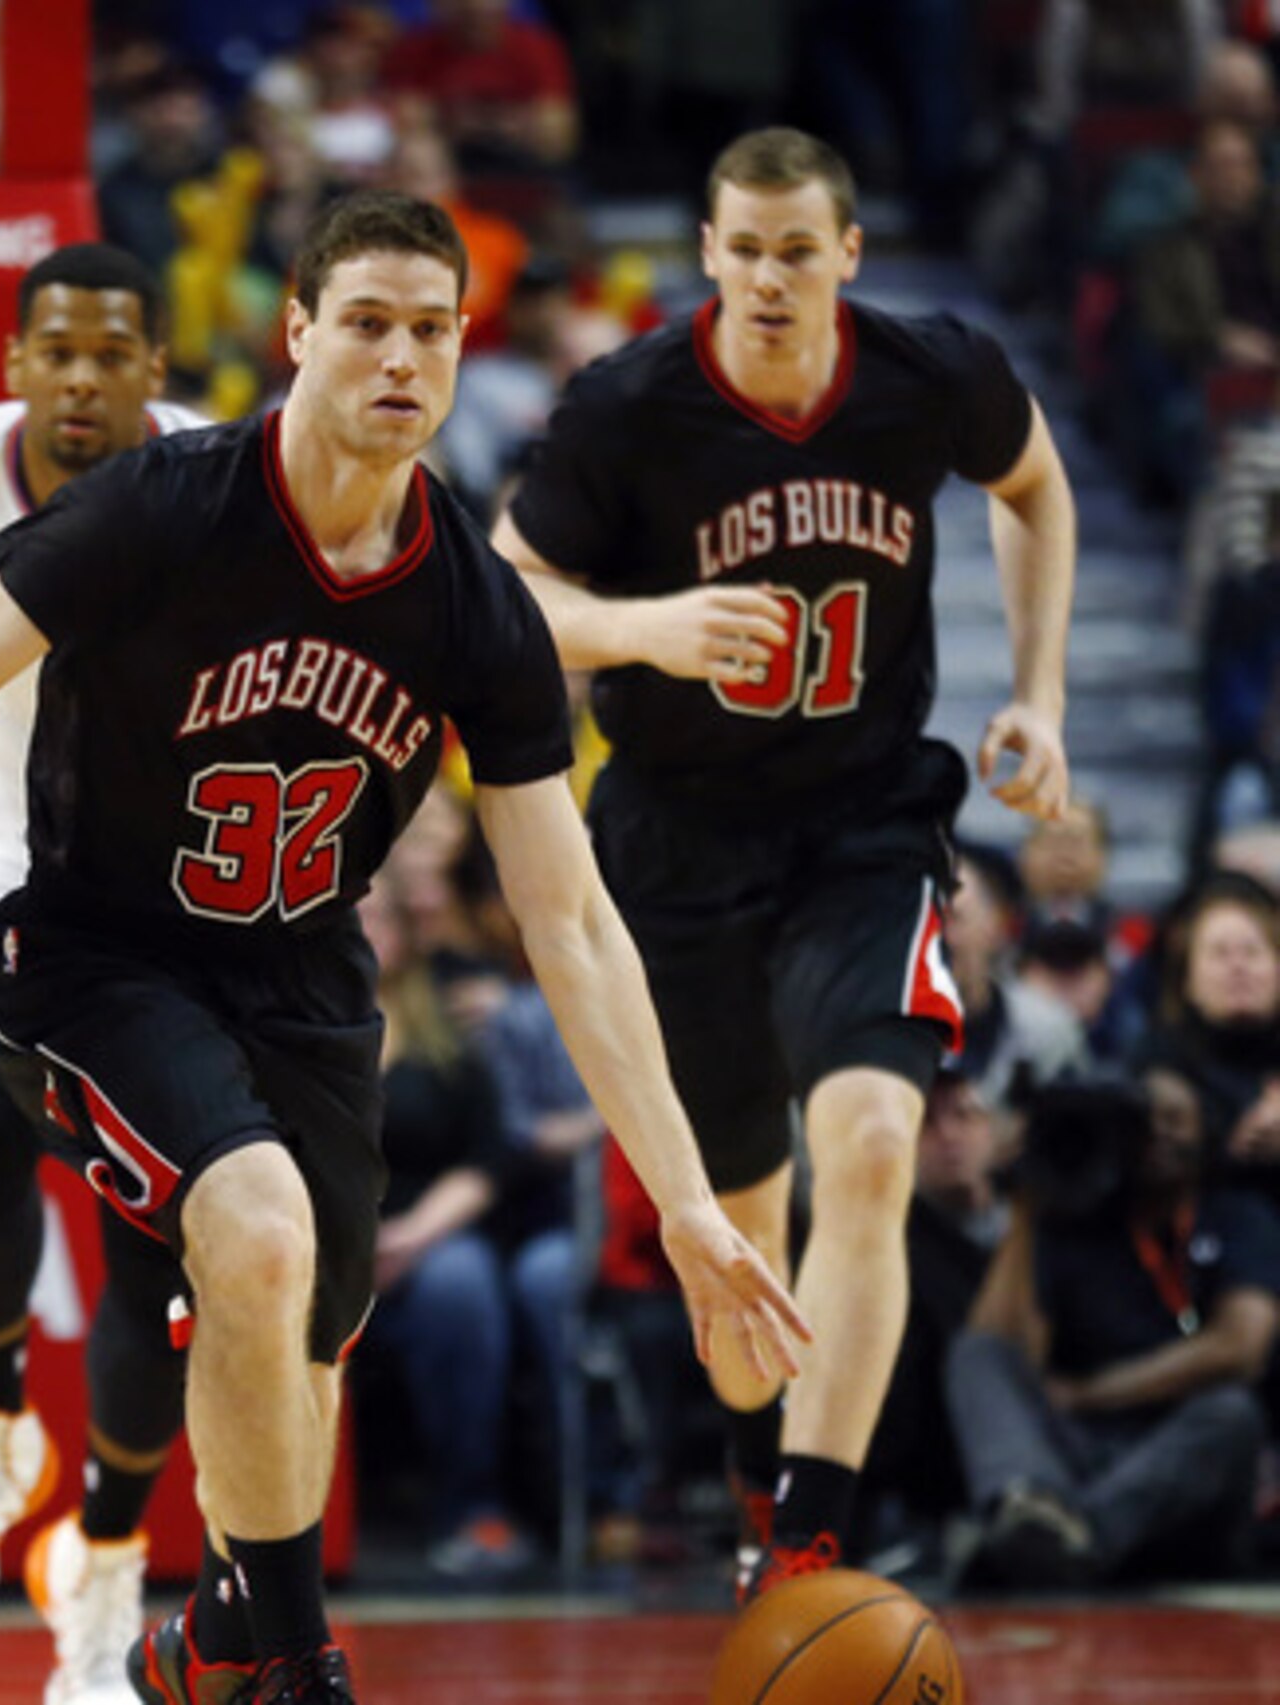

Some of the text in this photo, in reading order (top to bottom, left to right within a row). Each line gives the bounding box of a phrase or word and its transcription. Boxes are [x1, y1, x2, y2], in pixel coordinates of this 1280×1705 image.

[695, 477, 915, 581] LOS BULLS
[175, 636, 433, 772] LOS BULLS
[171, 756, 371, 924] 32
